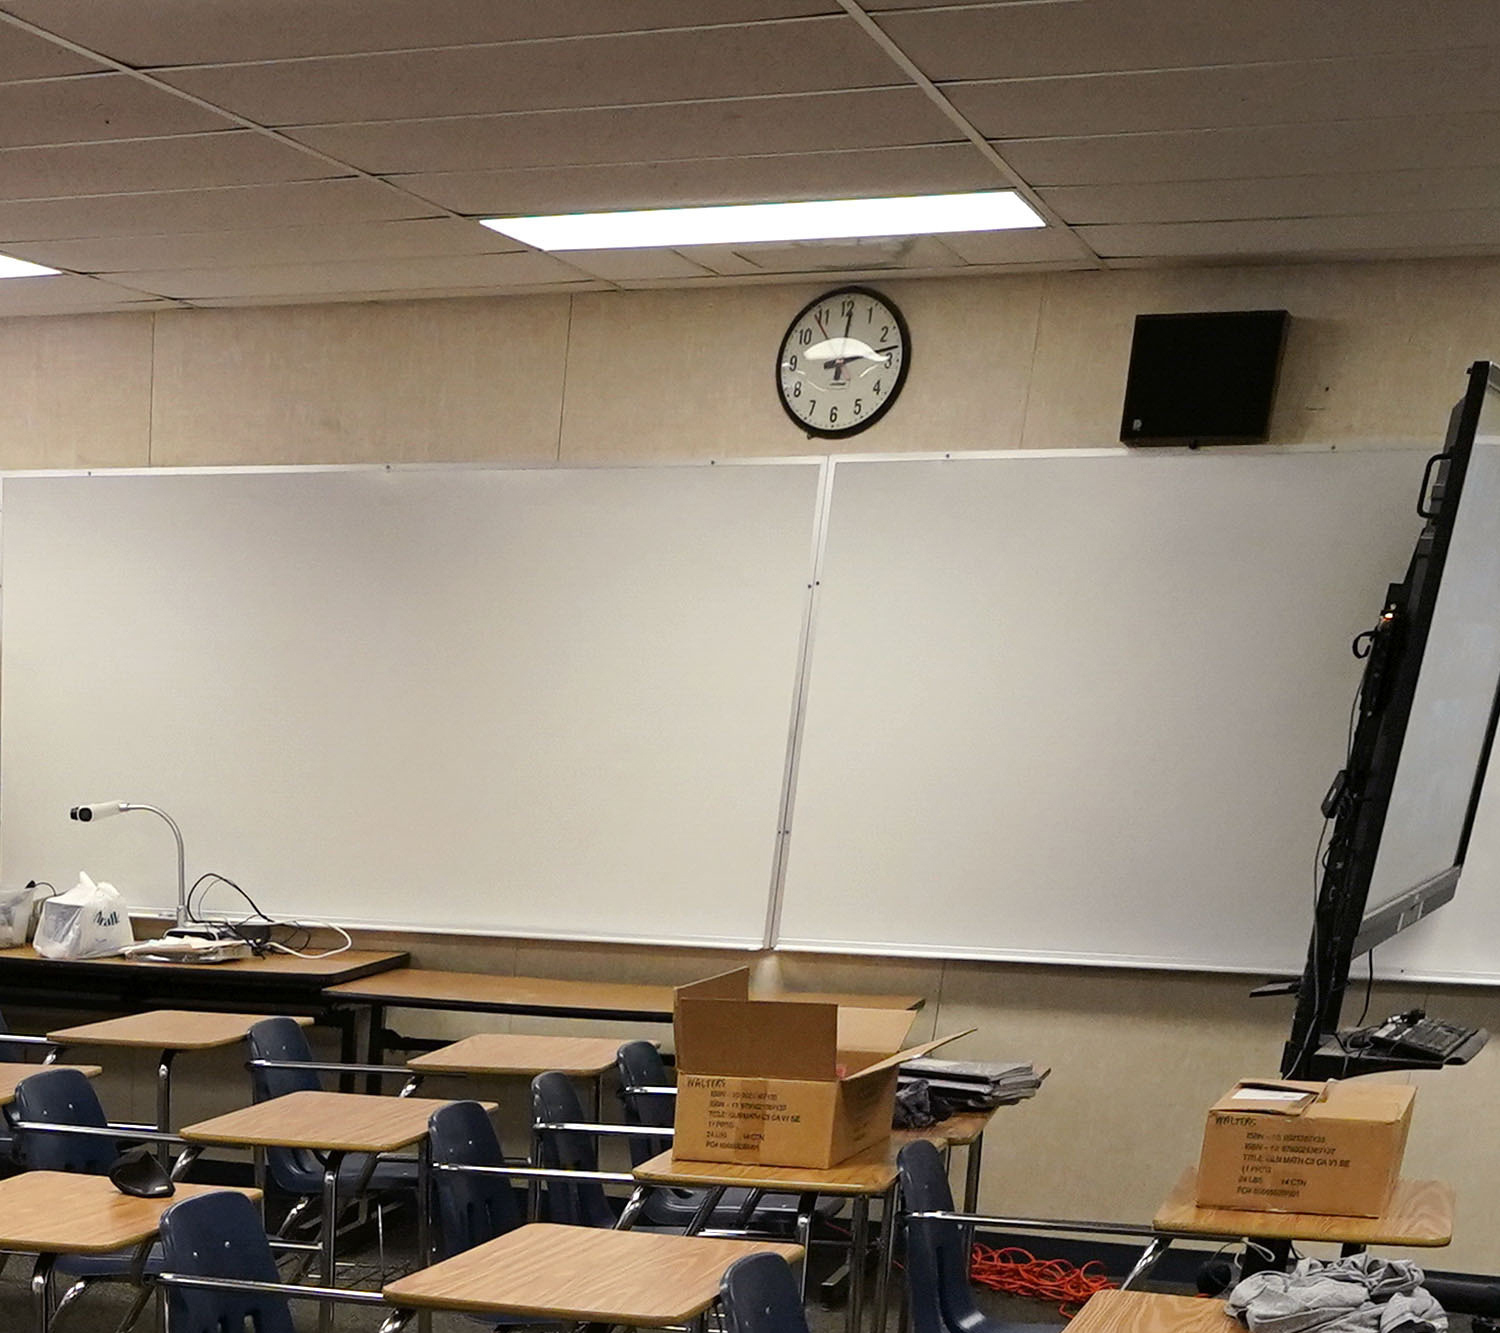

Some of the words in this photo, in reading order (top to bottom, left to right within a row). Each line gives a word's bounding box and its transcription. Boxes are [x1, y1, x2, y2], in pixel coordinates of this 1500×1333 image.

[818, 308, 830, 325] 11
[841, 300, 855, 317] 12
[867, 306, 873, 324] 1
[799, 328, 812, 345] 10
[880, 326, 889, 342] 2
[789, 355, 798, 371] 9
[884, 352, 893, 369] 3
[793, 381, 802, 398] 8
[873, 379, 881, 395] 4
[809, 400, 816, 416] 7
[829, 406, 838, 422] 6
[853, 398, 862, 415] 5
[687, 1077, 727, 1089] WALTERS
[1215, 1115, 1257, 1127] WALTERS
